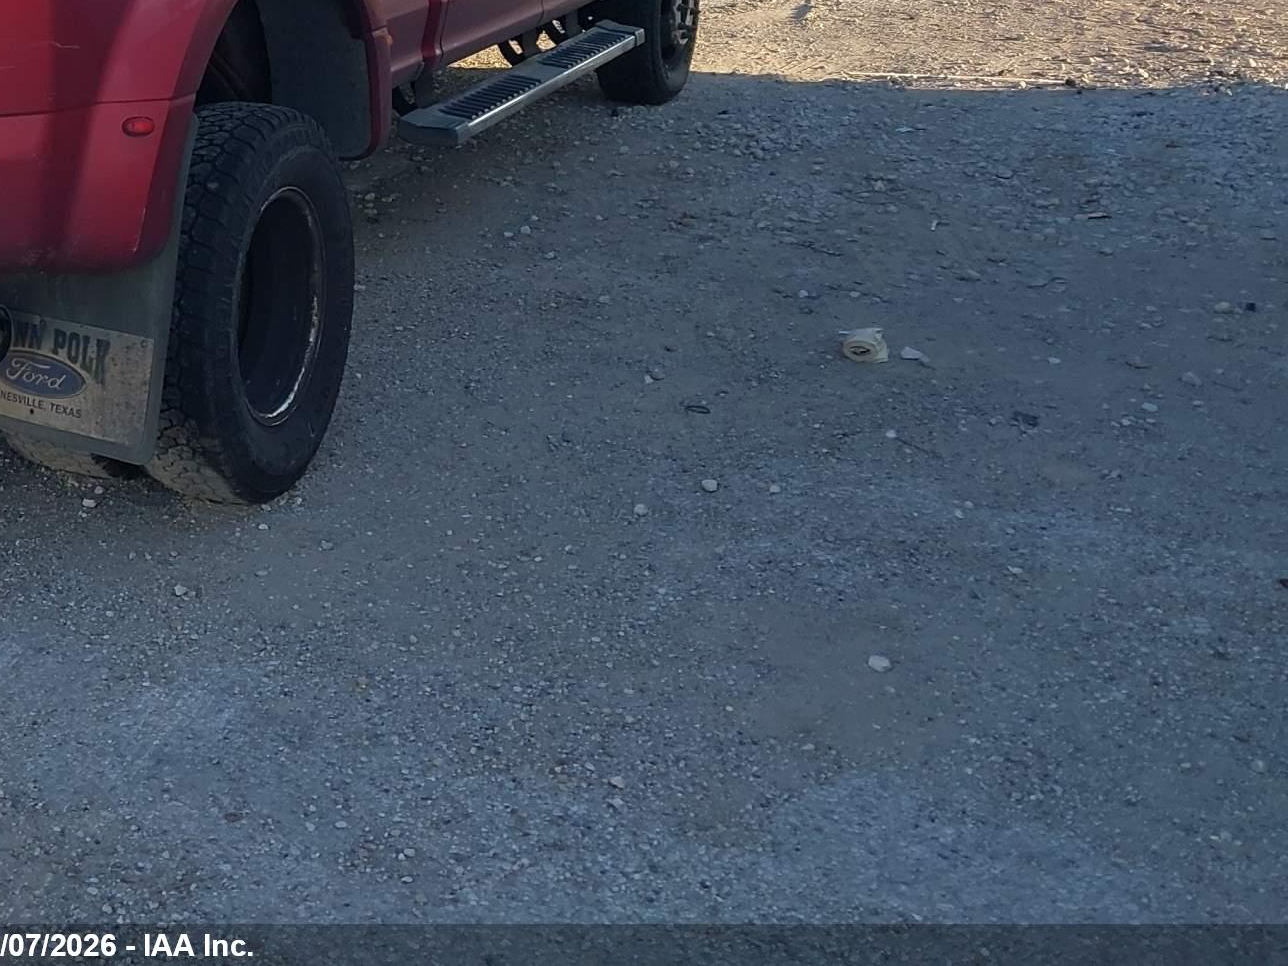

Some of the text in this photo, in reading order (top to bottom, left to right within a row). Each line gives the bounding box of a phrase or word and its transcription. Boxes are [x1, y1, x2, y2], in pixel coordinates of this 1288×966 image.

[52, 328, 111, 385] POLK
[6, 357, 66, 391] Ford
[49, 402, 82, 419] TEXAS
